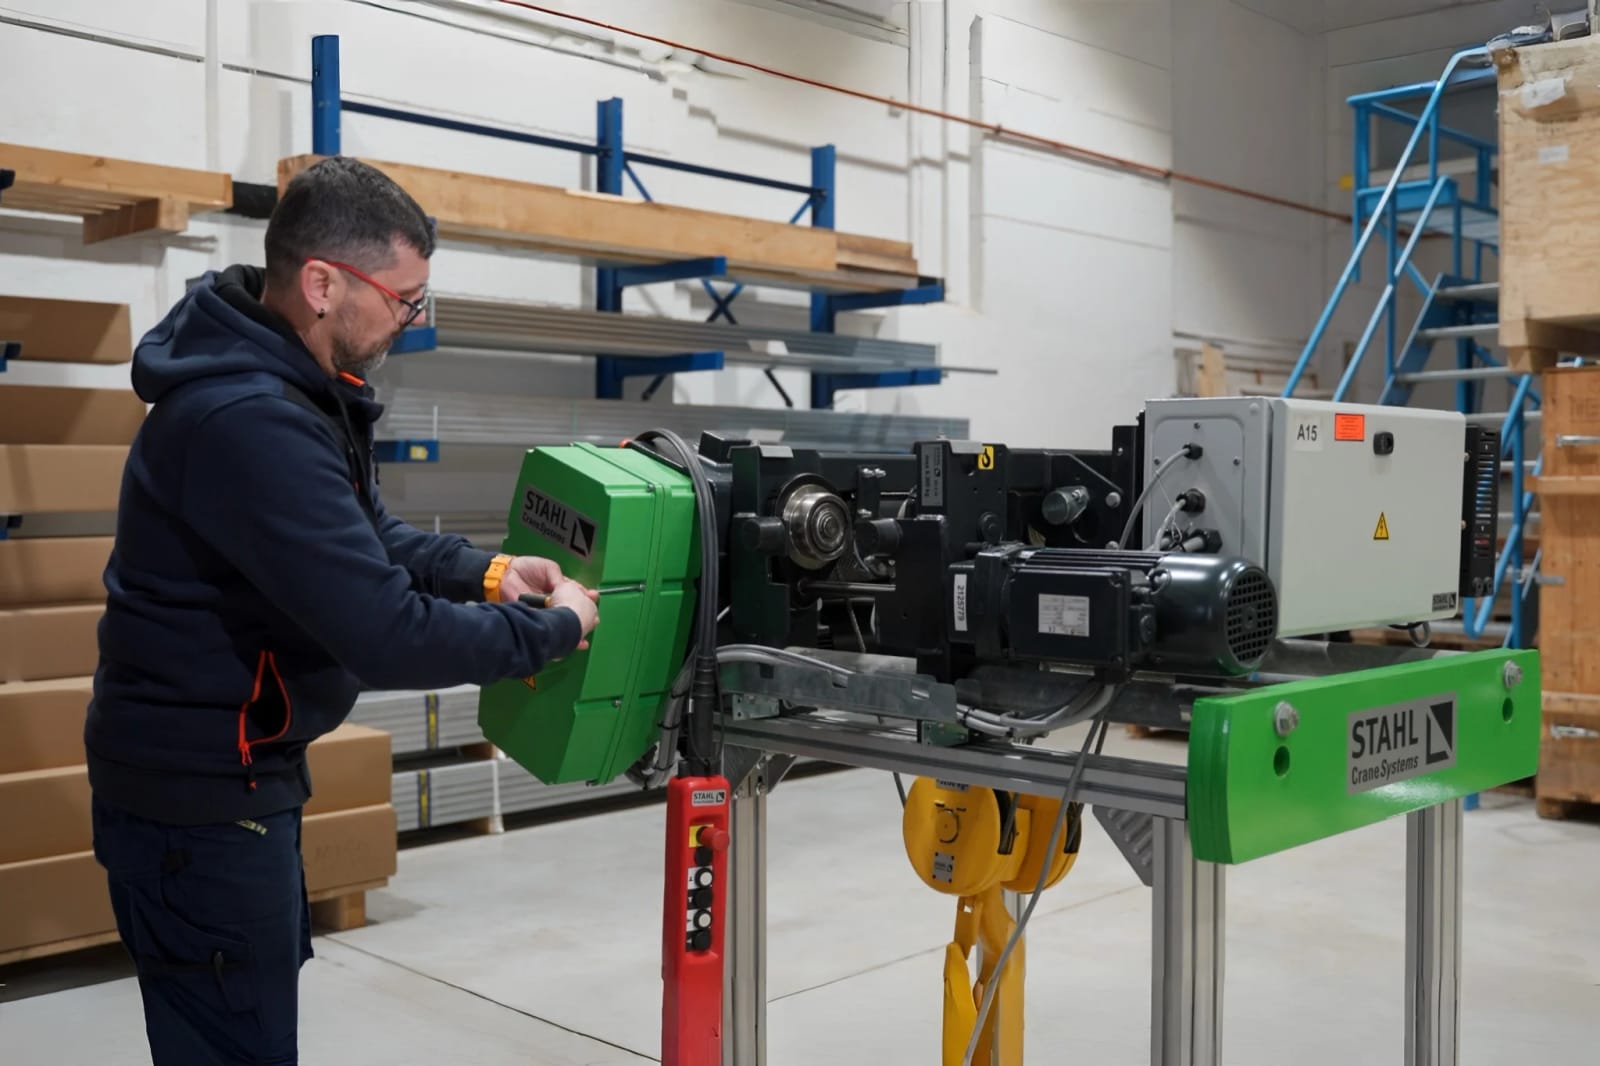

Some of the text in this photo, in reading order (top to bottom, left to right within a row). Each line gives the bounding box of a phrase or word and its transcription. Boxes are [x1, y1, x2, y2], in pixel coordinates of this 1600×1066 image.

[1297, 423, 1318, 441] A15
[524, 490, 568, 531] STAHL
[957, 585, 965, 622] 2125779
[1351, 709, 1419, 759] STAHL
[1351, 756, 1419, 785] CraneSystems
[694, 791, 714, 800] STAHL
